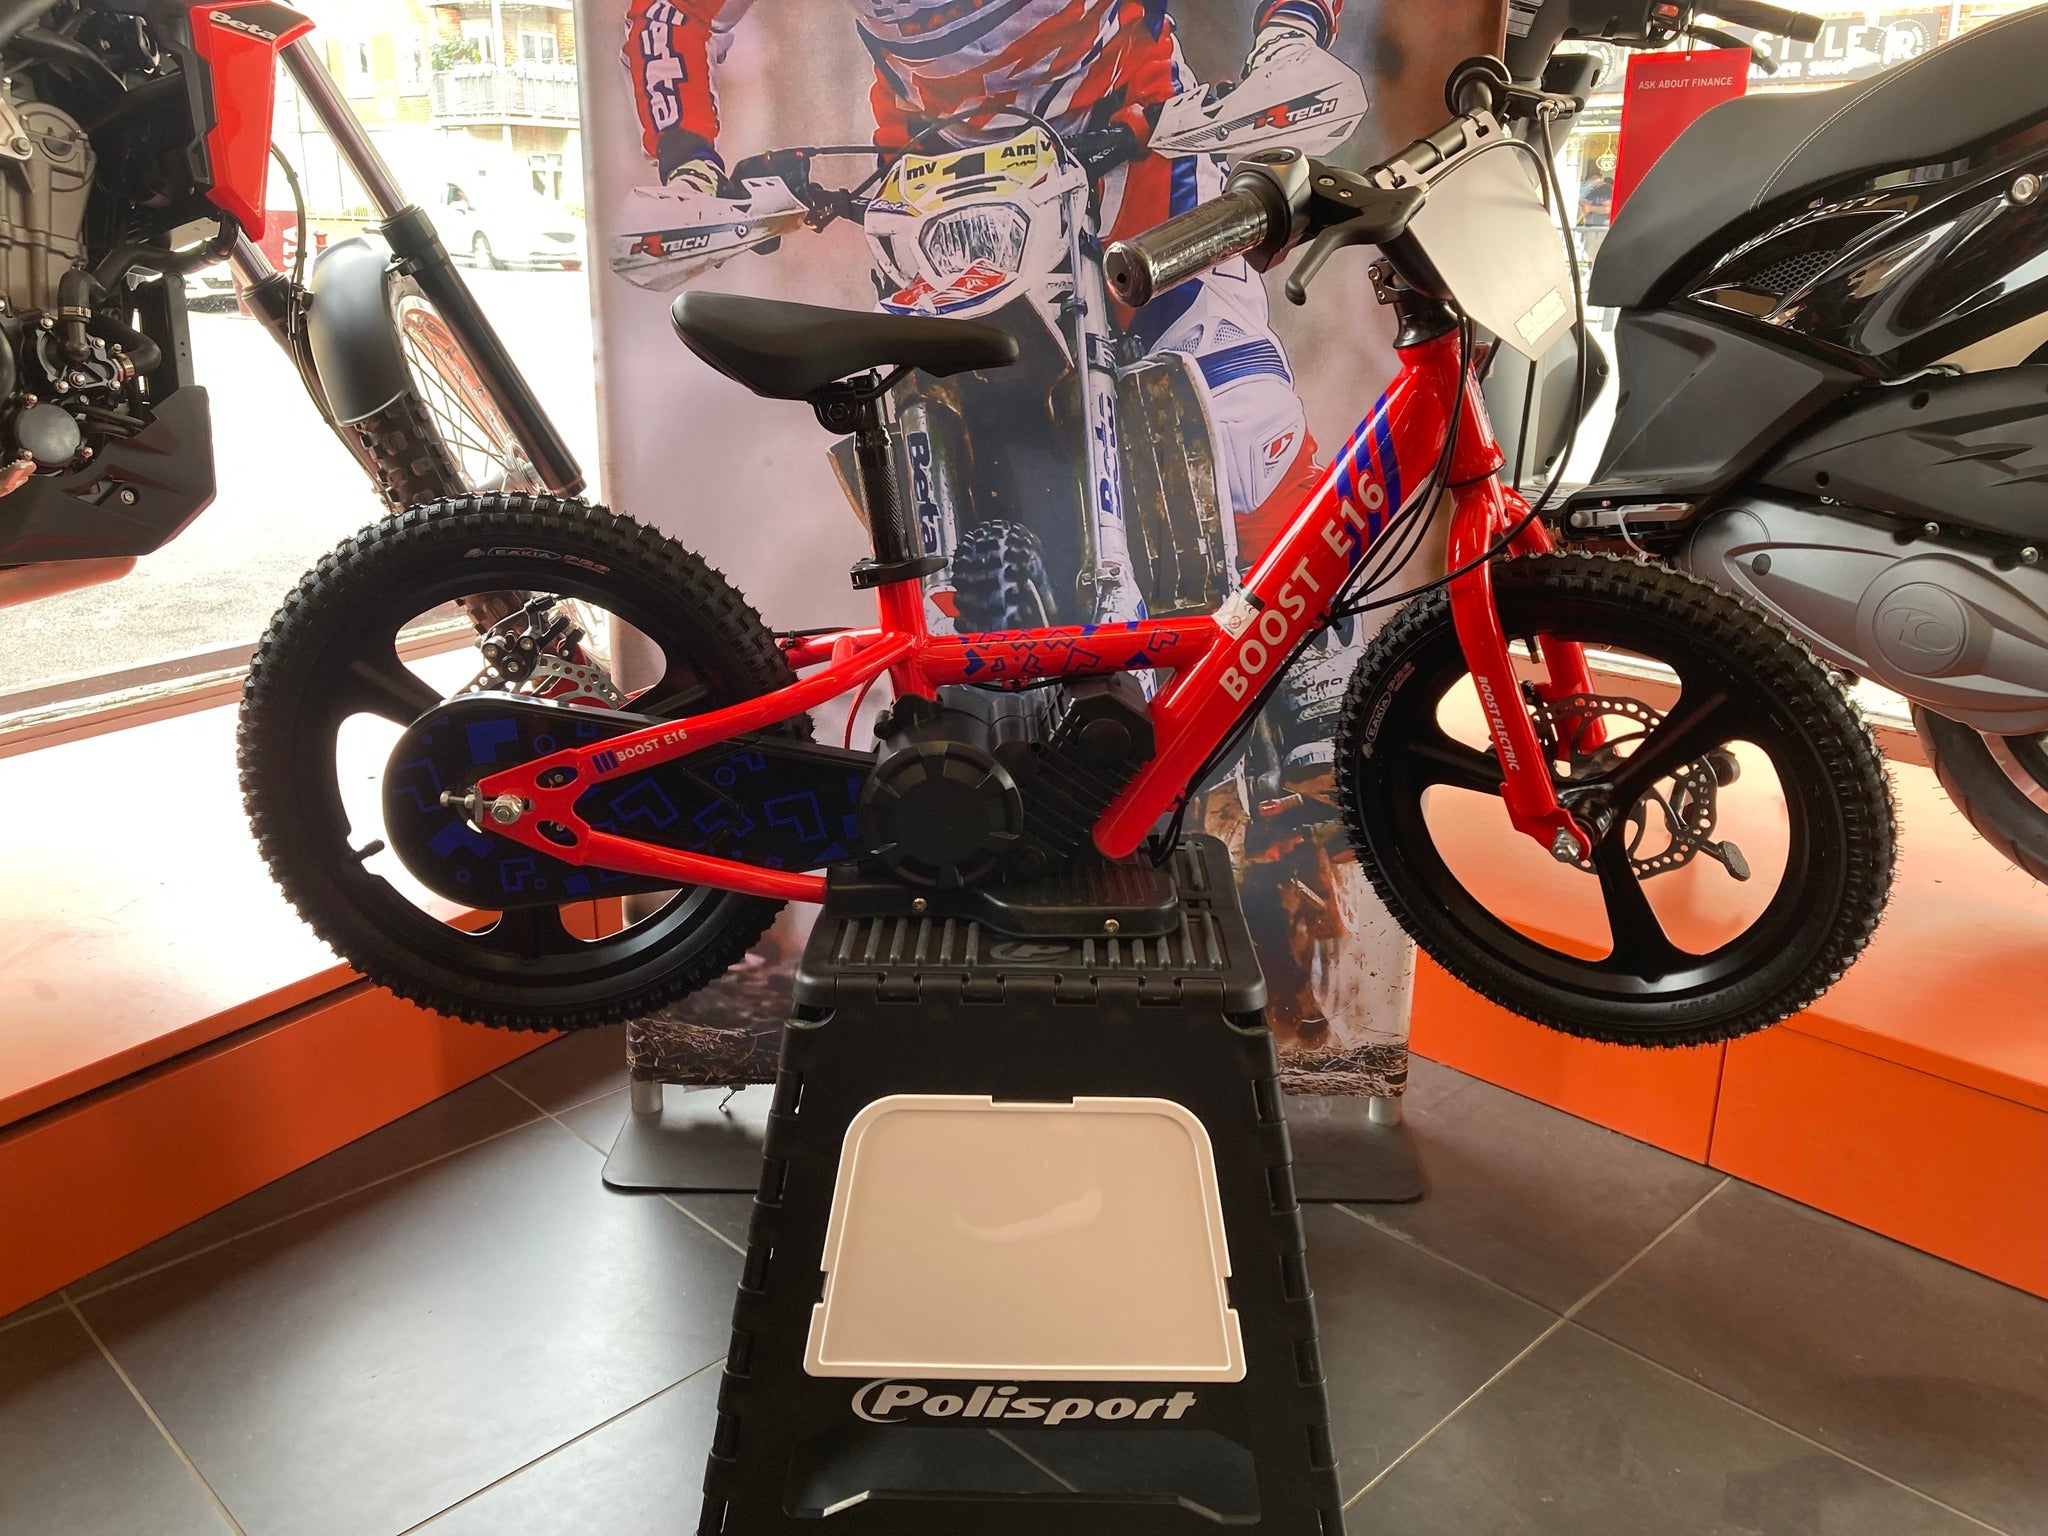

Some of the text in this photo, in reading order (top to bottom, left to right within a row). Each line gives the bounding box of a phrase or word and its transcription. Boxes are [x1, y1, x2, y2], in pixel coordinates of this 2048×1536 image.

[209, 10, 278, 40] Beta
[1638, 77, 1733, 90] ASK ABOUT FINANCE
[906, 431, 939, 555] Beta
[1218, 472, 1384, 702] BOOST E16
[616, 729, 688, 762] BOOST E16
[1477, 675, 1520, 771] BOOST ELECTRIC
[852, 1379, 1197, 1425] Polisport
